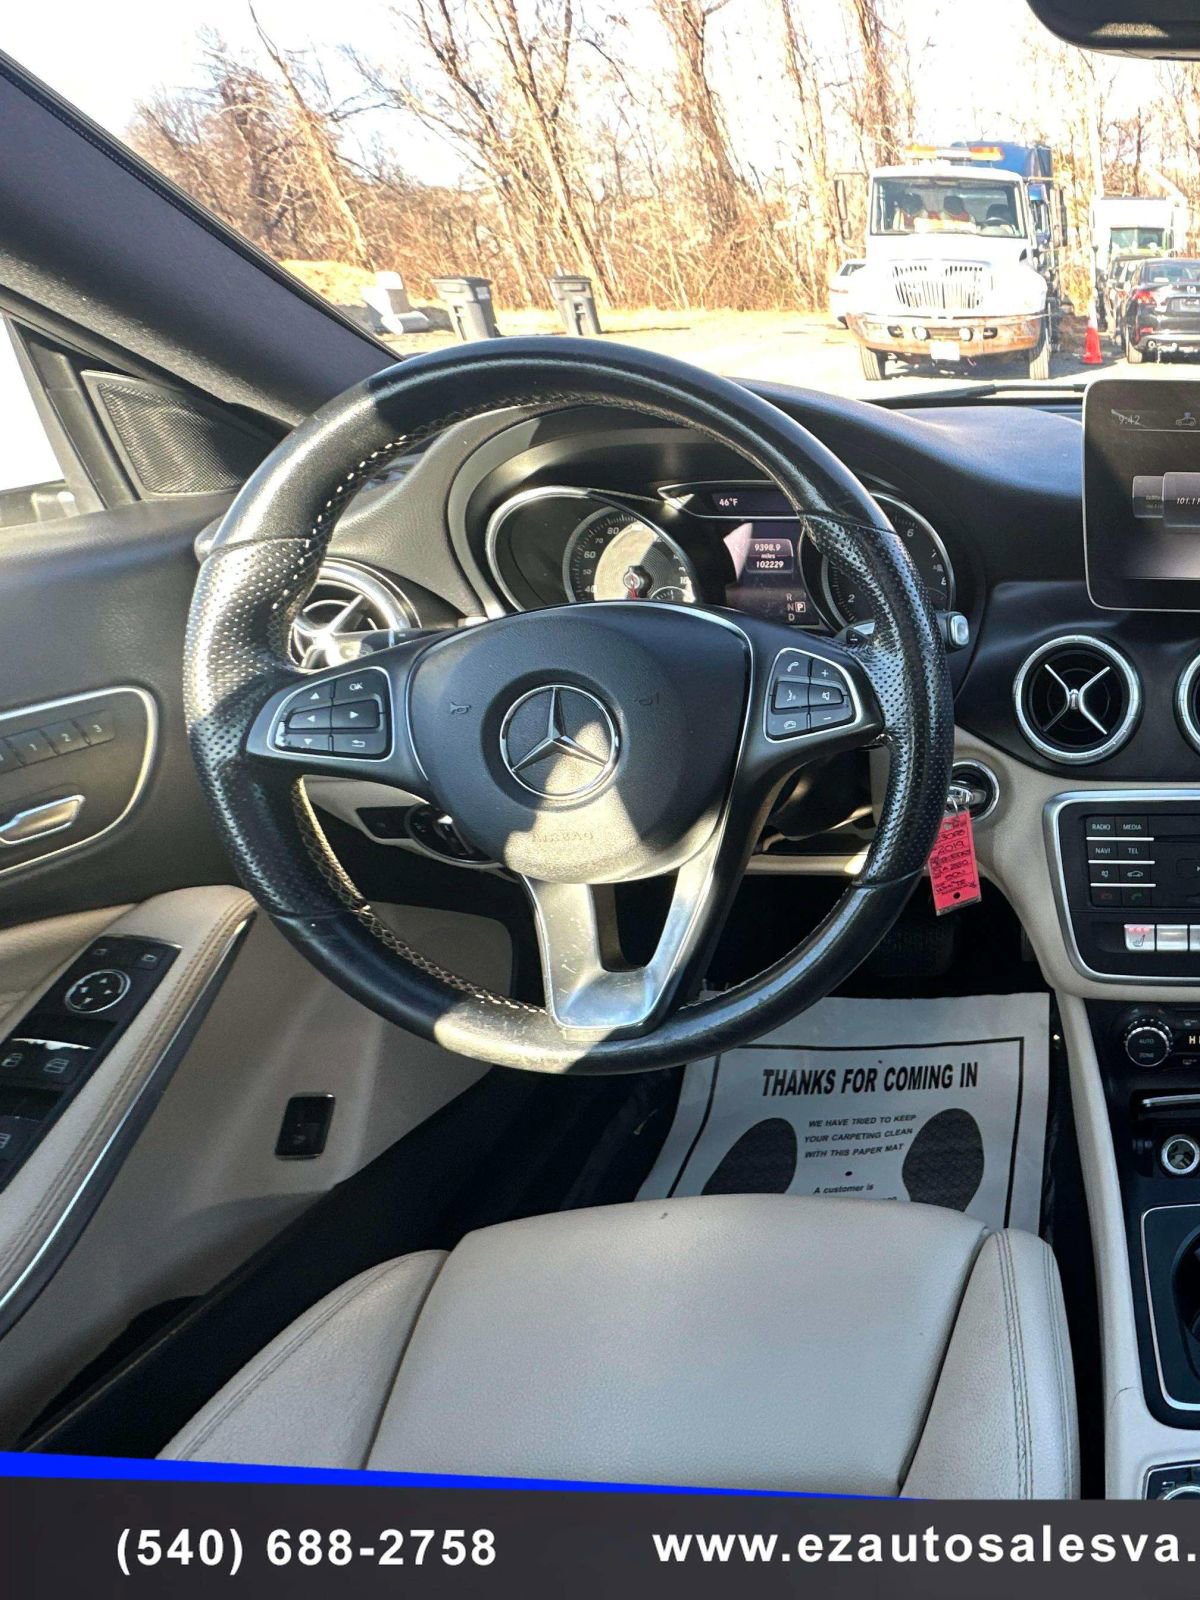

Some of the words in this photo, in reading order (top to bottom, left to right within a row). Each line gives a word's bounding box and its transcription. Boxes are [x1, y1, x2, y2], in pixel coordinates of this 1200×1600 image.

[1118, 415, 1140, 425] 9:42
[718, 498, 738, 507] 46°F
[1177, 497, 1195, 505] 101.1
[607, 527, 619, 535] 80
[906, 529, 914, 537] 6
[754, 543, 782, 552] 9398.9
[583, 551, 596, 559] 60
[756, 560, 785, 569] 102229
[848, 594, 856, 603] 2
[61, 733, 71, 742] 2
[92, 724, 103, 733] 3
[762, 1068, 836, 1097] THANKS
[841, 1067, 878, 1094] FOR
[883, 1064, 953, 1092] COMING
[959, 1062, 979, 1088] IN
[825, 1118, 848, 1127] HAVE
[852, 1117, 876, 1125] TRIED
[880, 1116, 891, 1124] TO
[893, 1114, 917, 1123] KEEP
[804, 1134, 828, 1143] YOUR
[832, 1132, 881, 1141] CARPETING
[884, 1128, 913, 1138] CLEAN
[804, 1150, 827, 1159] WITH
[830, 1148, 850, 1157] THIS
[852, 1147, 882, 1156] PAPER
[885, 1143, 904, 1152] MAT
[823, 1185, 864, 1193] customer
[866, 1183, 874, 1191] is
